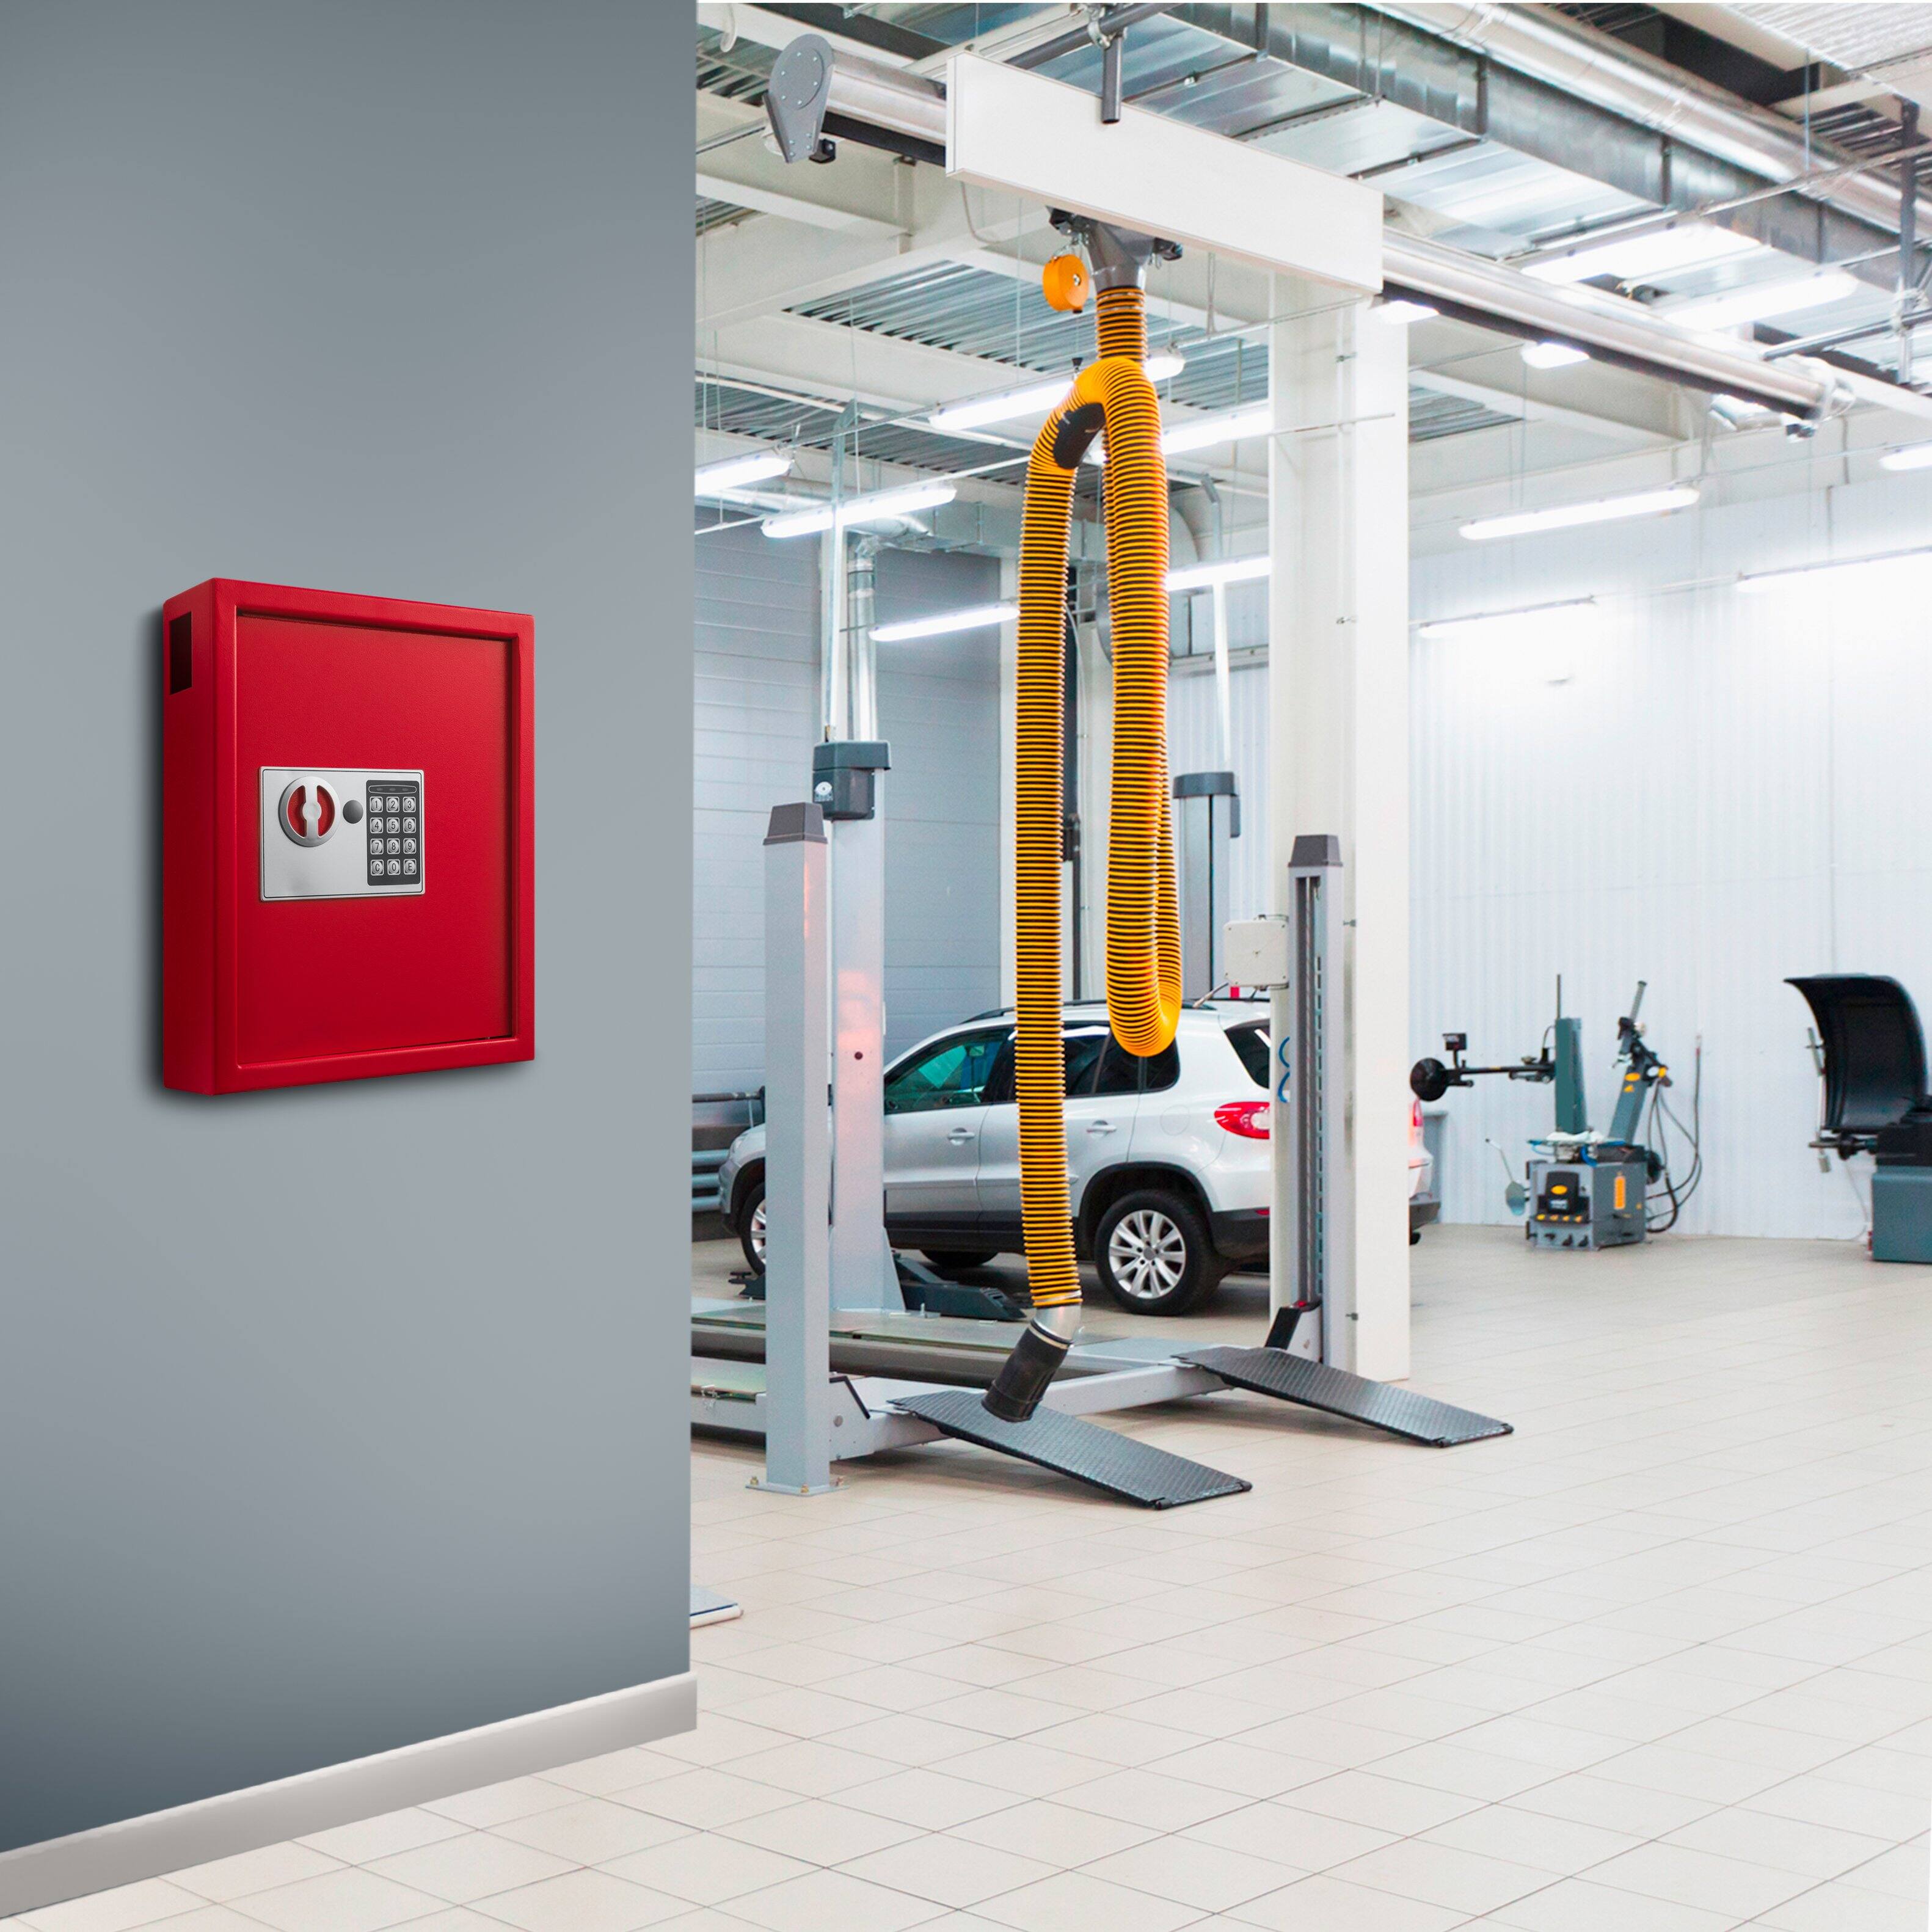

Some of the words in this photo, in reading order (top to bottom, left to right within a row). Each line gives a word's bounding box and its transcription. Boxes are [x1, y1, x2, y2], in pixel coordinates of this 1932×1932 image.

[391, 800, 395, 809] 2
[407, 800, 412, 809] 3
[408, 821, 412, 829] 6
[375, 842, 379, 851] 7
[408, 842, 412, 850] 9
[375, 863, 380, 872] C
[408, 862, 412, 871] E
